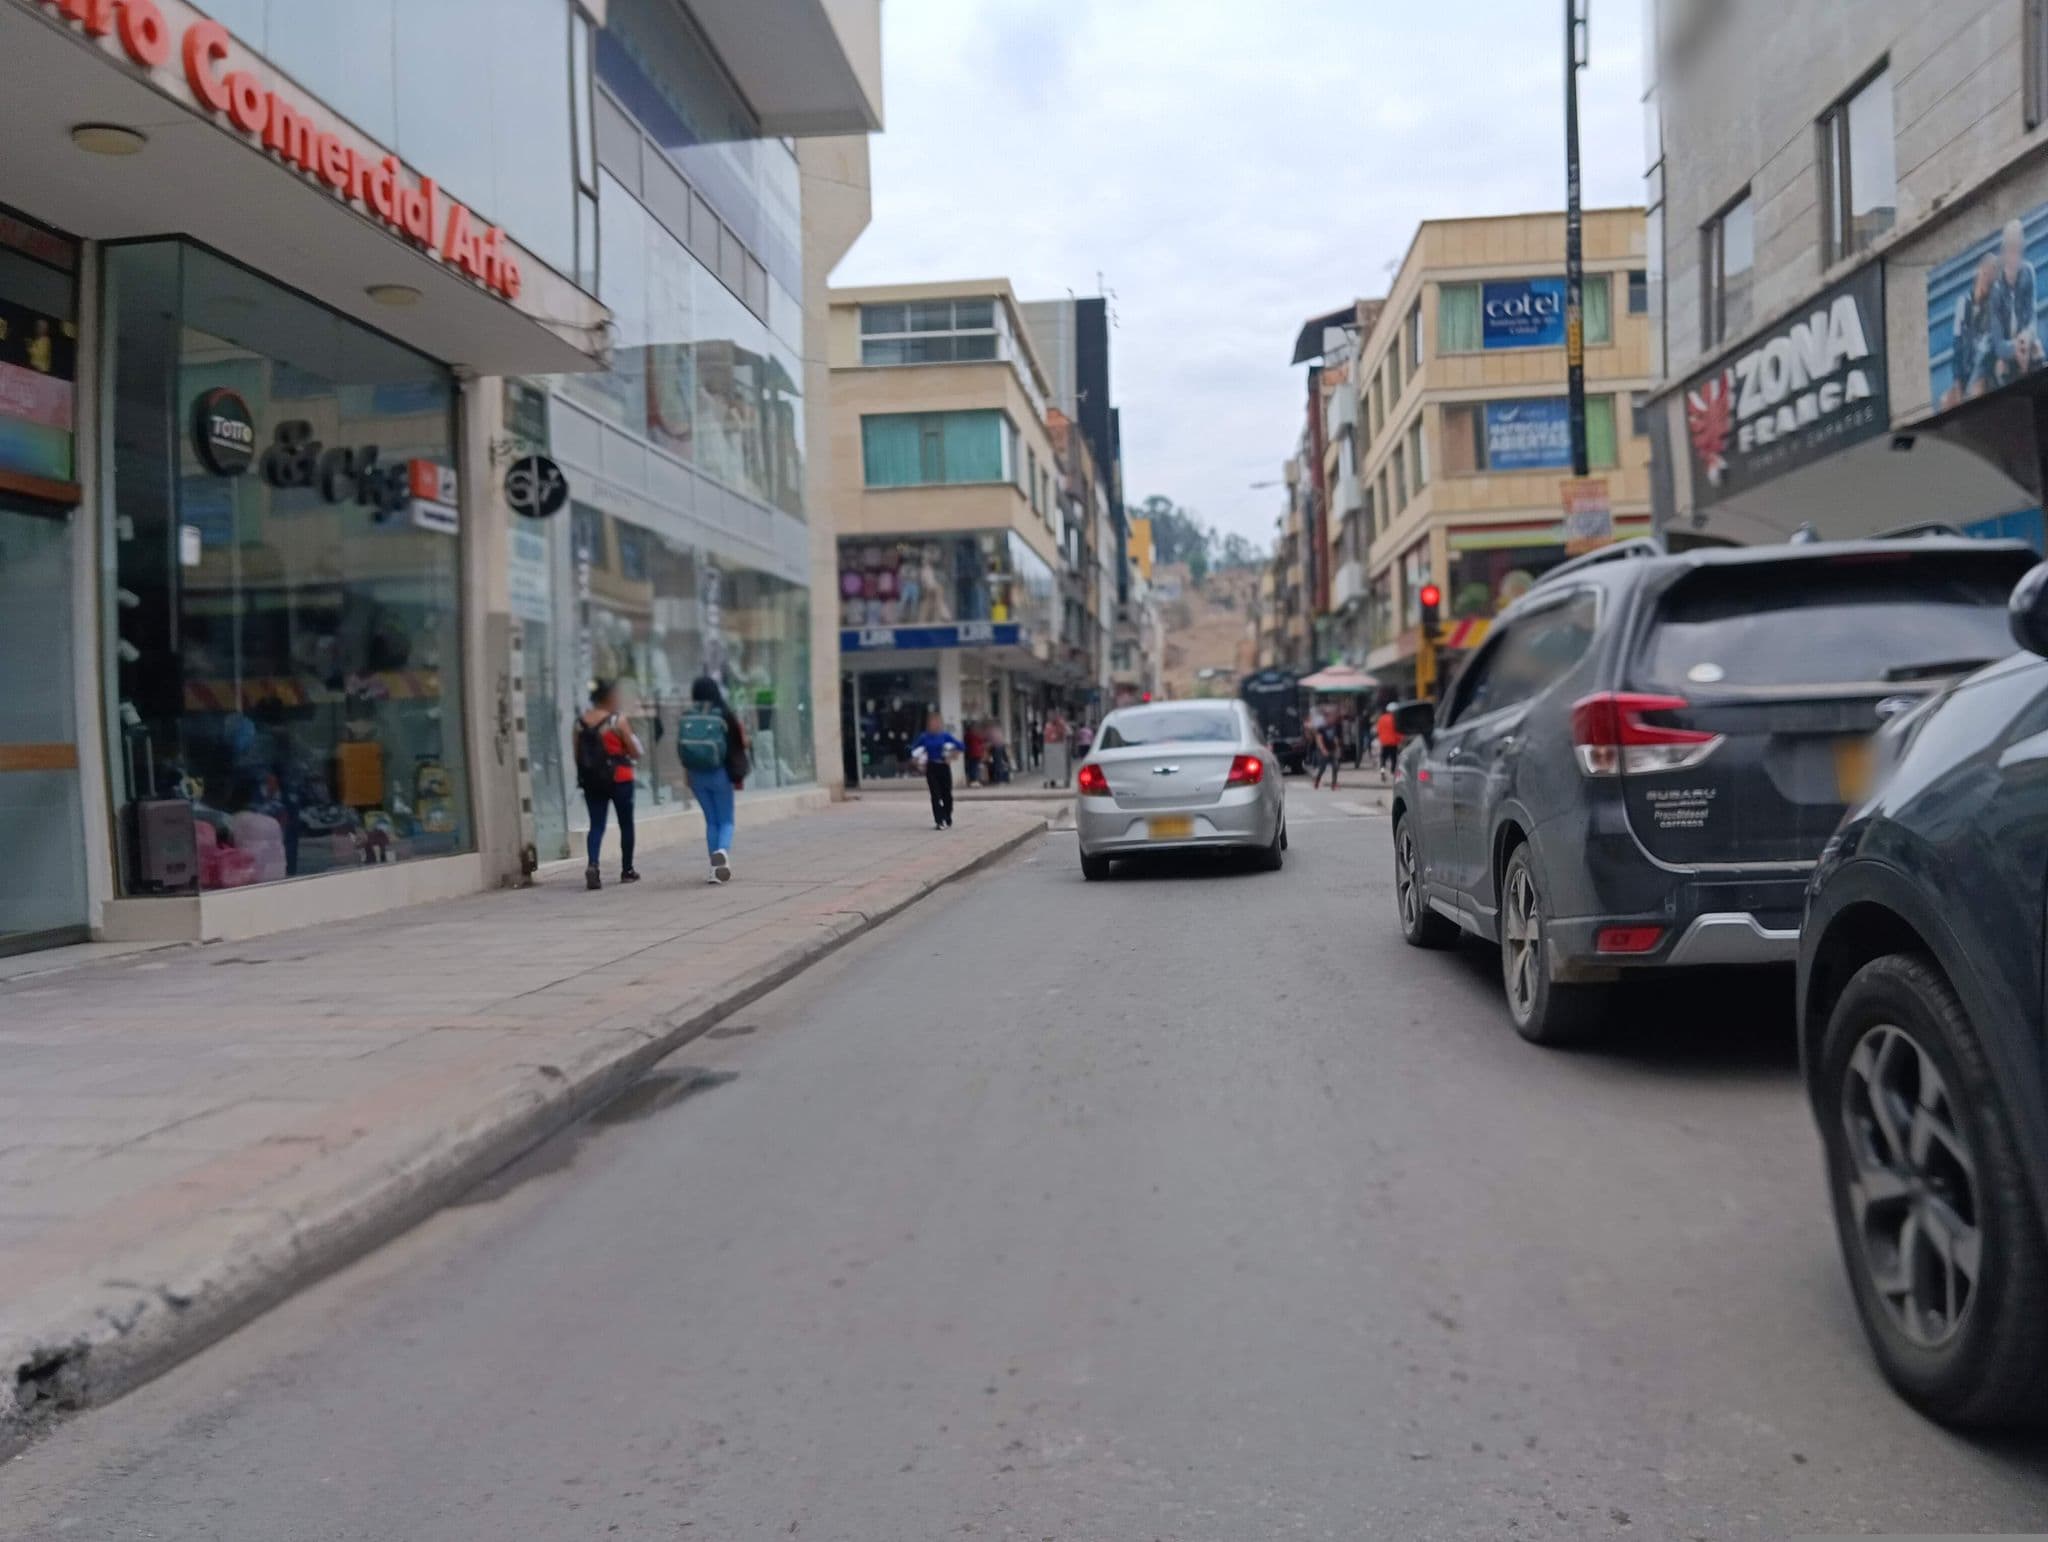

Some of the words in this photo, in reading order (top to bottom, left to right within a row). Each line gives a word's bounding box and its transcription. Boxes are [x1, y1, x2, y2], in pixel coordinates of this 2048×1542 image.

[182, 19, 438, 250] Comercial
[1486, 289, 1559, 318] cotel
[1735, 294, 1869, 420] ZONA
[210, 415, 252, 443] TOTTO
[1737, 369, 1871, 453] FRANCA
